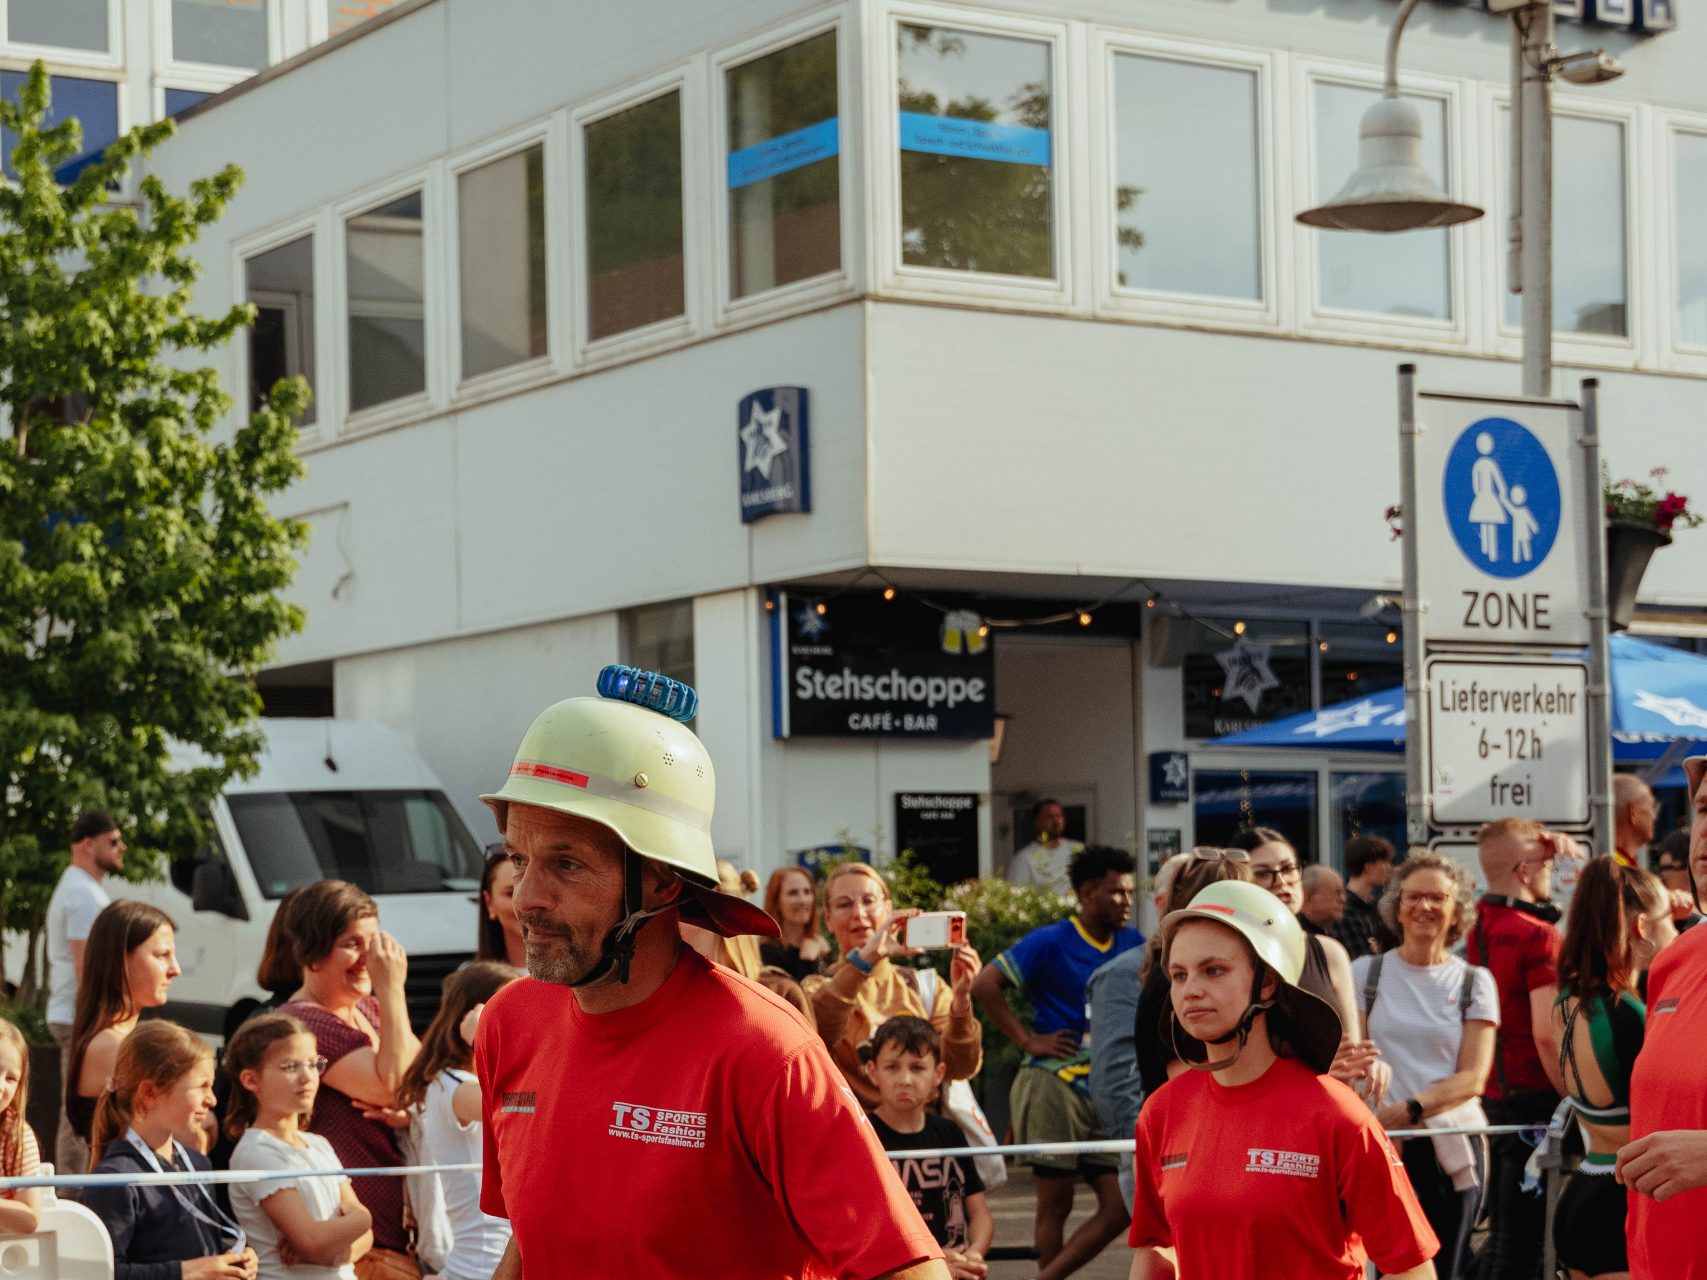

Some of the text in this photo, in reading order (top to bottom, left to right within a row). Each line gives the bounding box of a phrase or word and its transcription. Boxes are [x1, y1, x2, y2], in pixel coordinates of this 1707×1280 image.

[1462, 590, 1552, 631] ZONE
[796, 665, 986, 709] Stehschoppe
[1439, 679, 1576, 714] Lieferverkehr
[848, 711, 939, 731] CAFÉ BAR
[1489, 774, 1531, 806] frei
[901, 794, 973, 811] Stehschoppe
[612, 1104, 706, 1130] TS SPORTS
[608, 1127, 705, 1149] www.ts-sportsfashion.de
[653, 1122, 706, 1138] Fashion
[1247, 1150, 1320, 1167] TS SPORTS
[1277, 1160, 1319, 1173] Fashion
